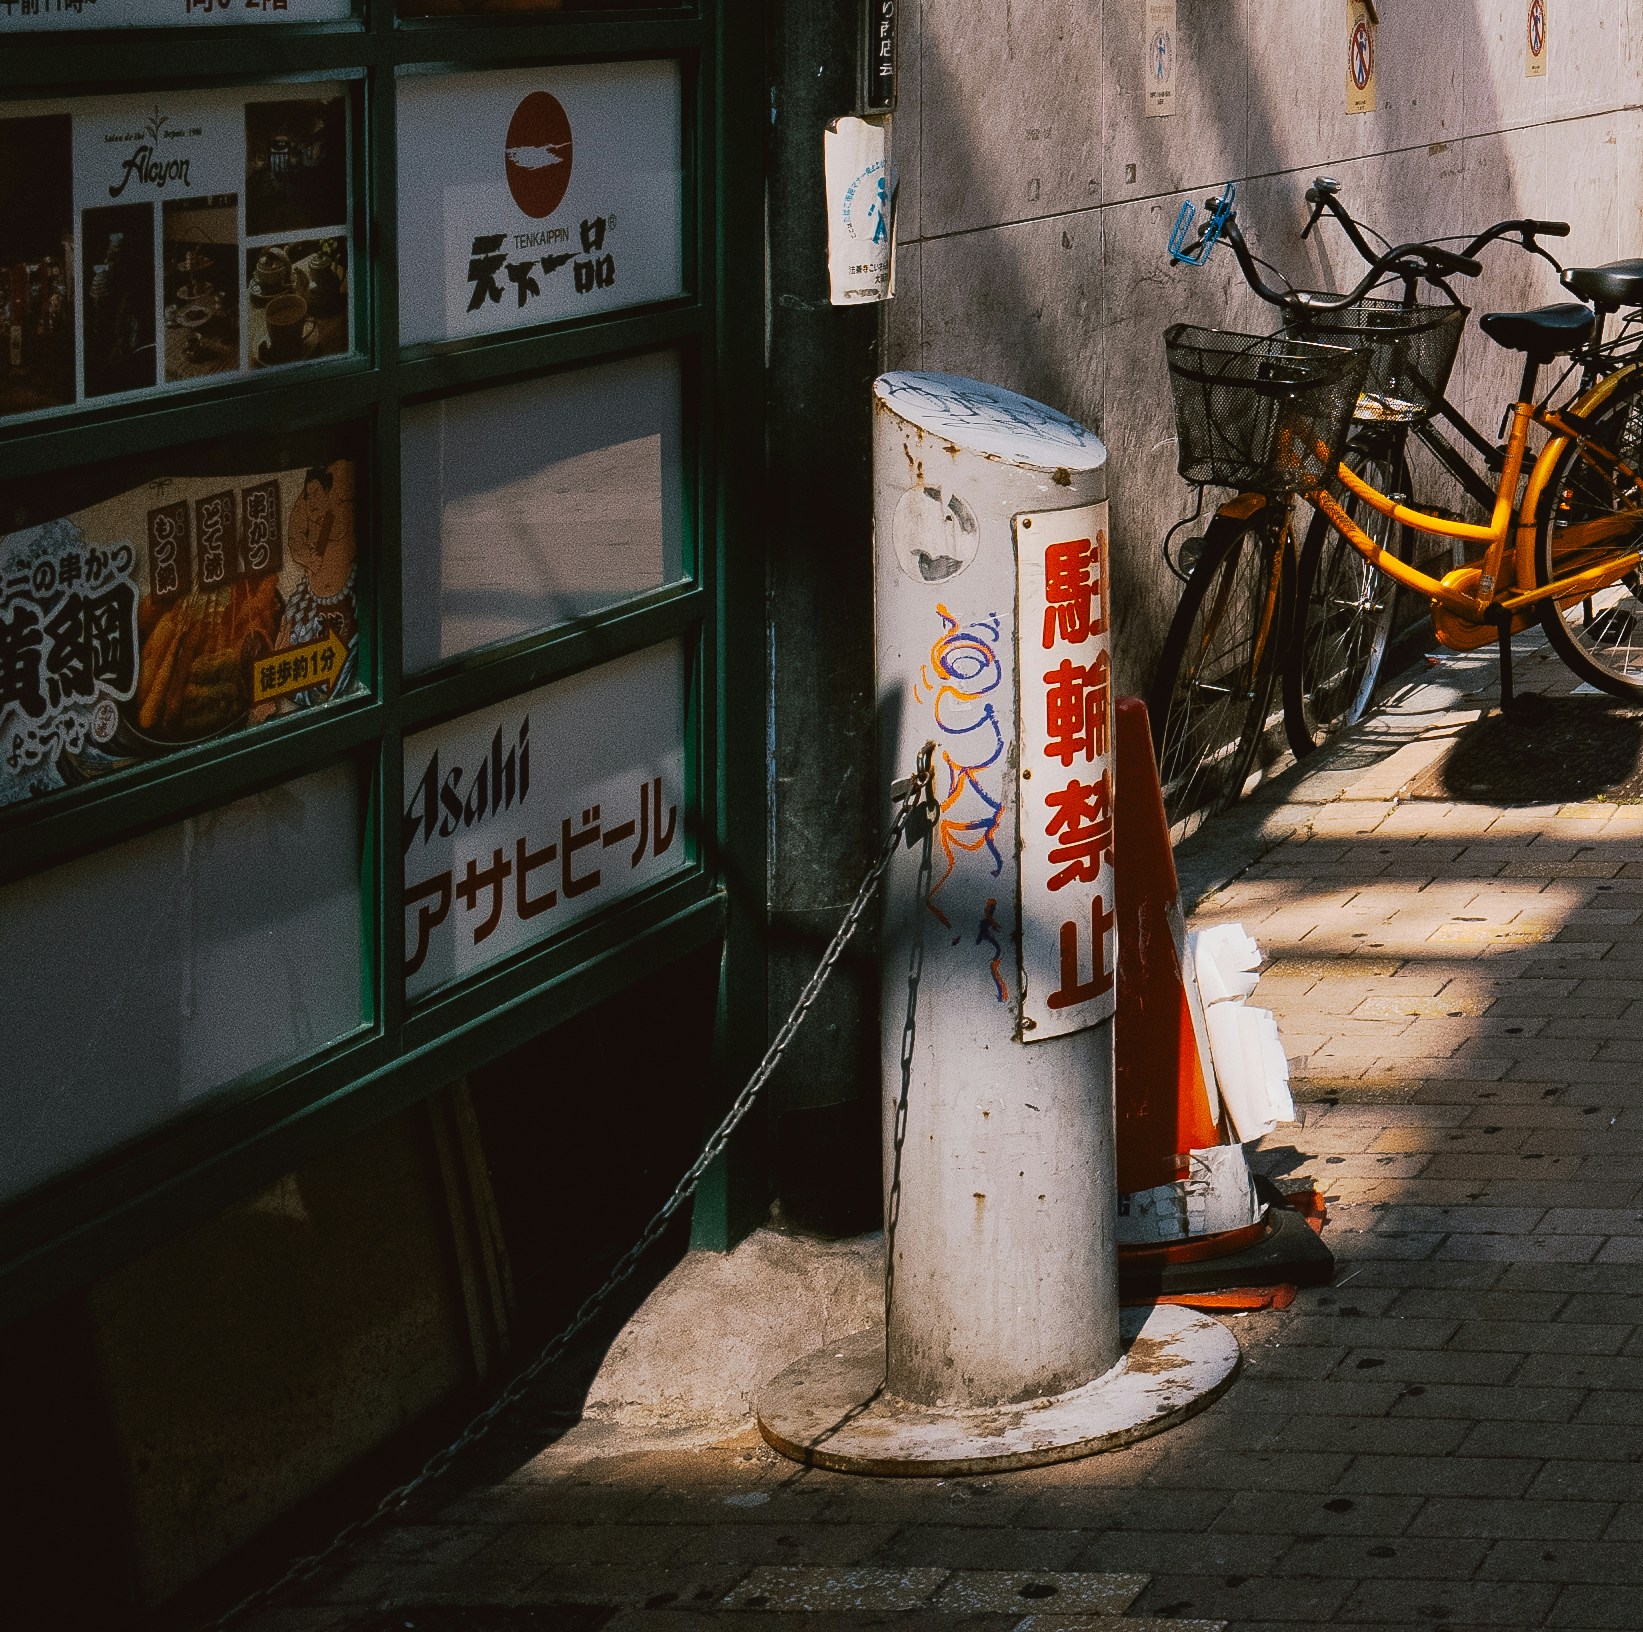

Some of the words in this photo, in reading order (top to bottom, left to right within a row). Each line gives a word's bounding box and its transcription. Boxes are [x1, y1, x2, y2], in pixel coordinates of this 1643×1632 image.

[466, 217, 616, 313] 天下一品
[513, 227, 569, 249] TENKAIPPIN
[260, 647, 336, 692] 徒歩約1分
[403, 713, 530, 857] Asahi
[1043, 538, 1116, 1010] 駐輪禁止
[404, 777, 677, 978] アサヒビール
